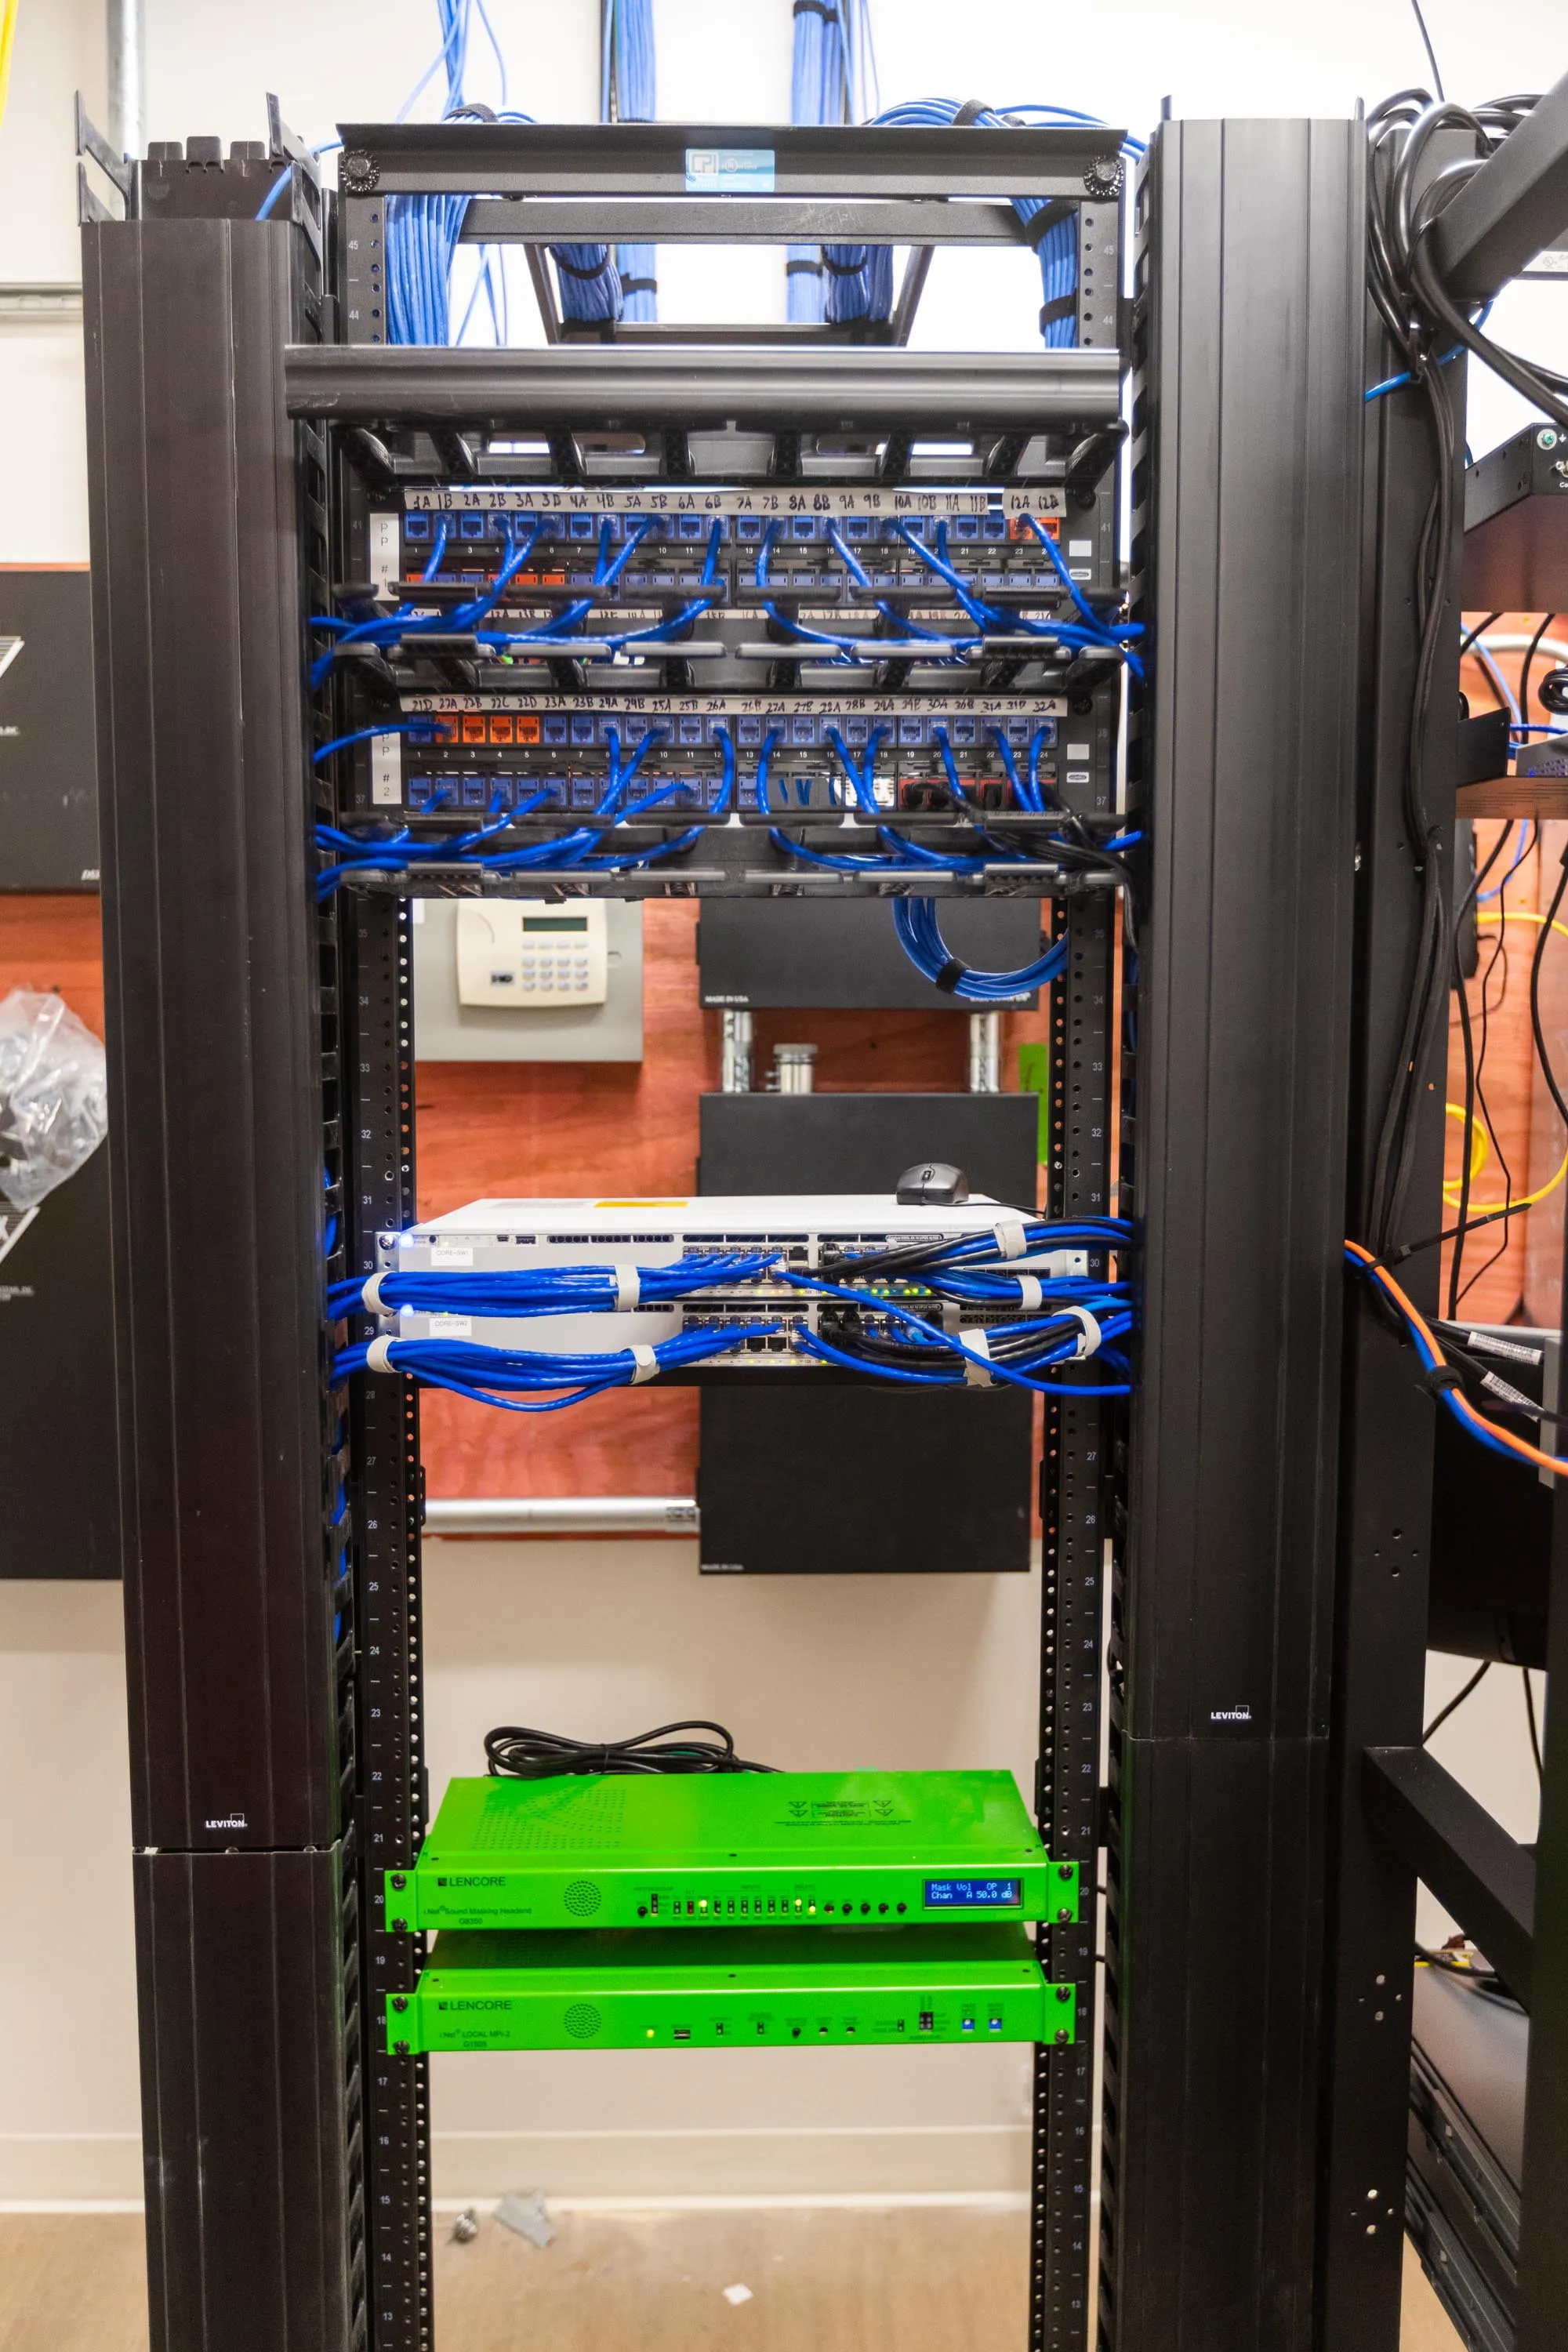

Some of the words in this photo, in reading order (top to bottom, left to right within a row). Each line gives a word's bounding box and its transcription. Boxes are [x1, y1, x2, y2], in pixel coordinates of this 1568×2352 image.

[348, 240, 358, 250] 45
[349, 310, 359, 320] 44
[1102, 315, 1113, 325] 44
[437, 494, 452, 510] 1B
[464, 494, 481, 506] 2A
[489, 493, 506, 507] 2B
[516, 493, 533, 507] 3A
[570, 495, 588, 508] 4A
[597, 494, 615, 508] 4B
[624, 495, 641, 509] 5A
[651, 494, 667, 509] 5B
[678, 494, 695, 509] 6A
[705, 495, 721, 508] 6B
[736, 495, 752, 510] 7A
[763, 495, 779, 510] 7B
[789, 495, 806, 511] 8A
[839, 495, 855, 509] 9A
[863, 494, 880, 508] 9B
[1011, 495, 1030, 510] 12A
[1101, 522, 1111, 532] 41
[572, 697, 593, 709] 23B
[652, 699, 671, 713] 25A
[680, 699, 699, 711] 25B
[765, 702, 786, 713] 27A
[927, 699, 948, 712] 30A
[1033, 701, 1056, 713] 32A
[1097, 796, 1107, 806] 37
[360, 1063, 370, 1073] 33
[1092, 1062, 1103, 1072] 33
[361, 1130, 372, 1138] 32
[1091, 1127, 1102, 1138] 32
[363, 1195, 372, 1204] 31
[1091, 1192, 1101, 1202] 31
[363, 1261, 373, 1270] 30
[1090, 1258, 1100, 1268] 30
[364, 1327, 375, 1335] 29
[367, 1456, 376, 1465] 27
[1087, 1451, 1097, 1461] 27
[1086, 1515, 1096, 1524] 26
[368, 1520, 378, 1530] 26
[1085, 1577, 1095, 1586] 25
[368, 1582, 379, 1592] 25
[1083, 1639, 1094, 1649] 24
[370, 1646, 380, 1655] 24
[1083, 1702, 1093, 1712] 23
[371, 1708, 381, 1718] 23
[1081, 1764, 1091, 1773] 22
[372, 1772, 383, 1781] 22
[205, 1820, 245, 1828] LEVITON
[1080, 1826, 1091, 1835] 21
[373, 1833, 383, 1842] 21
[449, 1876, 506, 1886] LENCORE
[956, 1882, 971, 1891] Vol
[1080, 1887, 1090, 1896] 20
[1078, 1947, 1088, 1956] 19
[376, 1956, 386, 1965] 19
[450, 2000, 512, 2010] LENCORE
[1076, 2067, 1086, 2075] 17
[379, 2136, 389, 2145] 16
[380, 2195, 390, 2205] 15
[382, 2252, 391, 2261] 14
